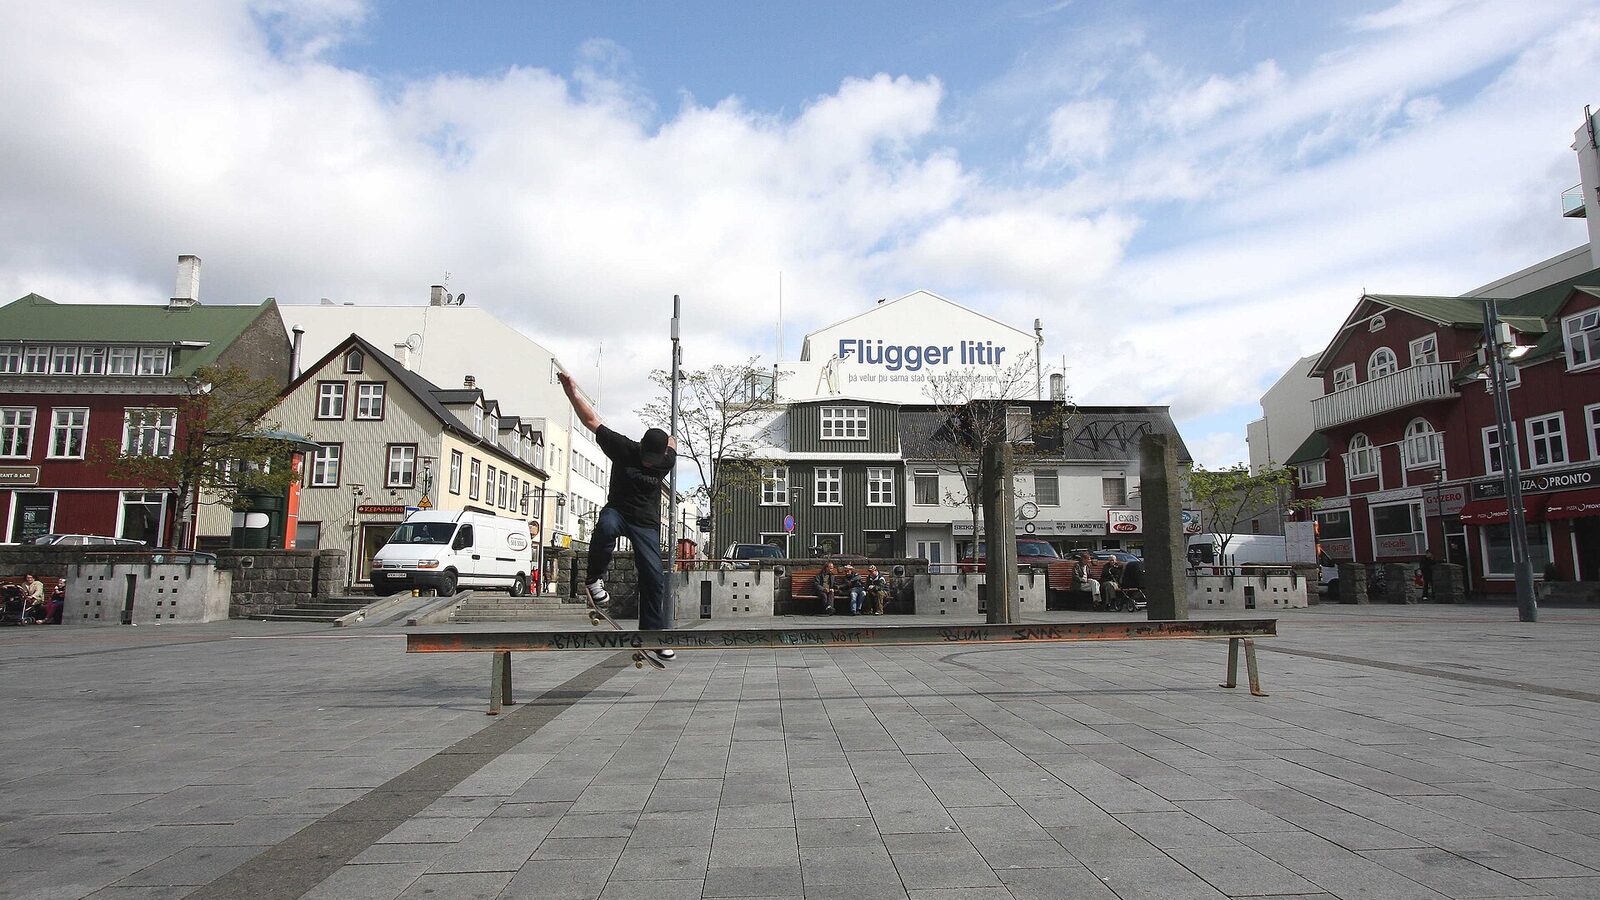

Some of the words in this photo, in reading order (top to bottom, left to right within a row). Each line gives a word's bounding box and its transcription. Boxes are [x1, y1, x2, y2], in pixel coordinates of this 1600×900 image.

[839, 339, 954, 372] Flügger
[960, 340, 1006, 365] litir
[1549, 472, 1592, 487] PRONTO
[1111, 512, 1140, 522] Texas
